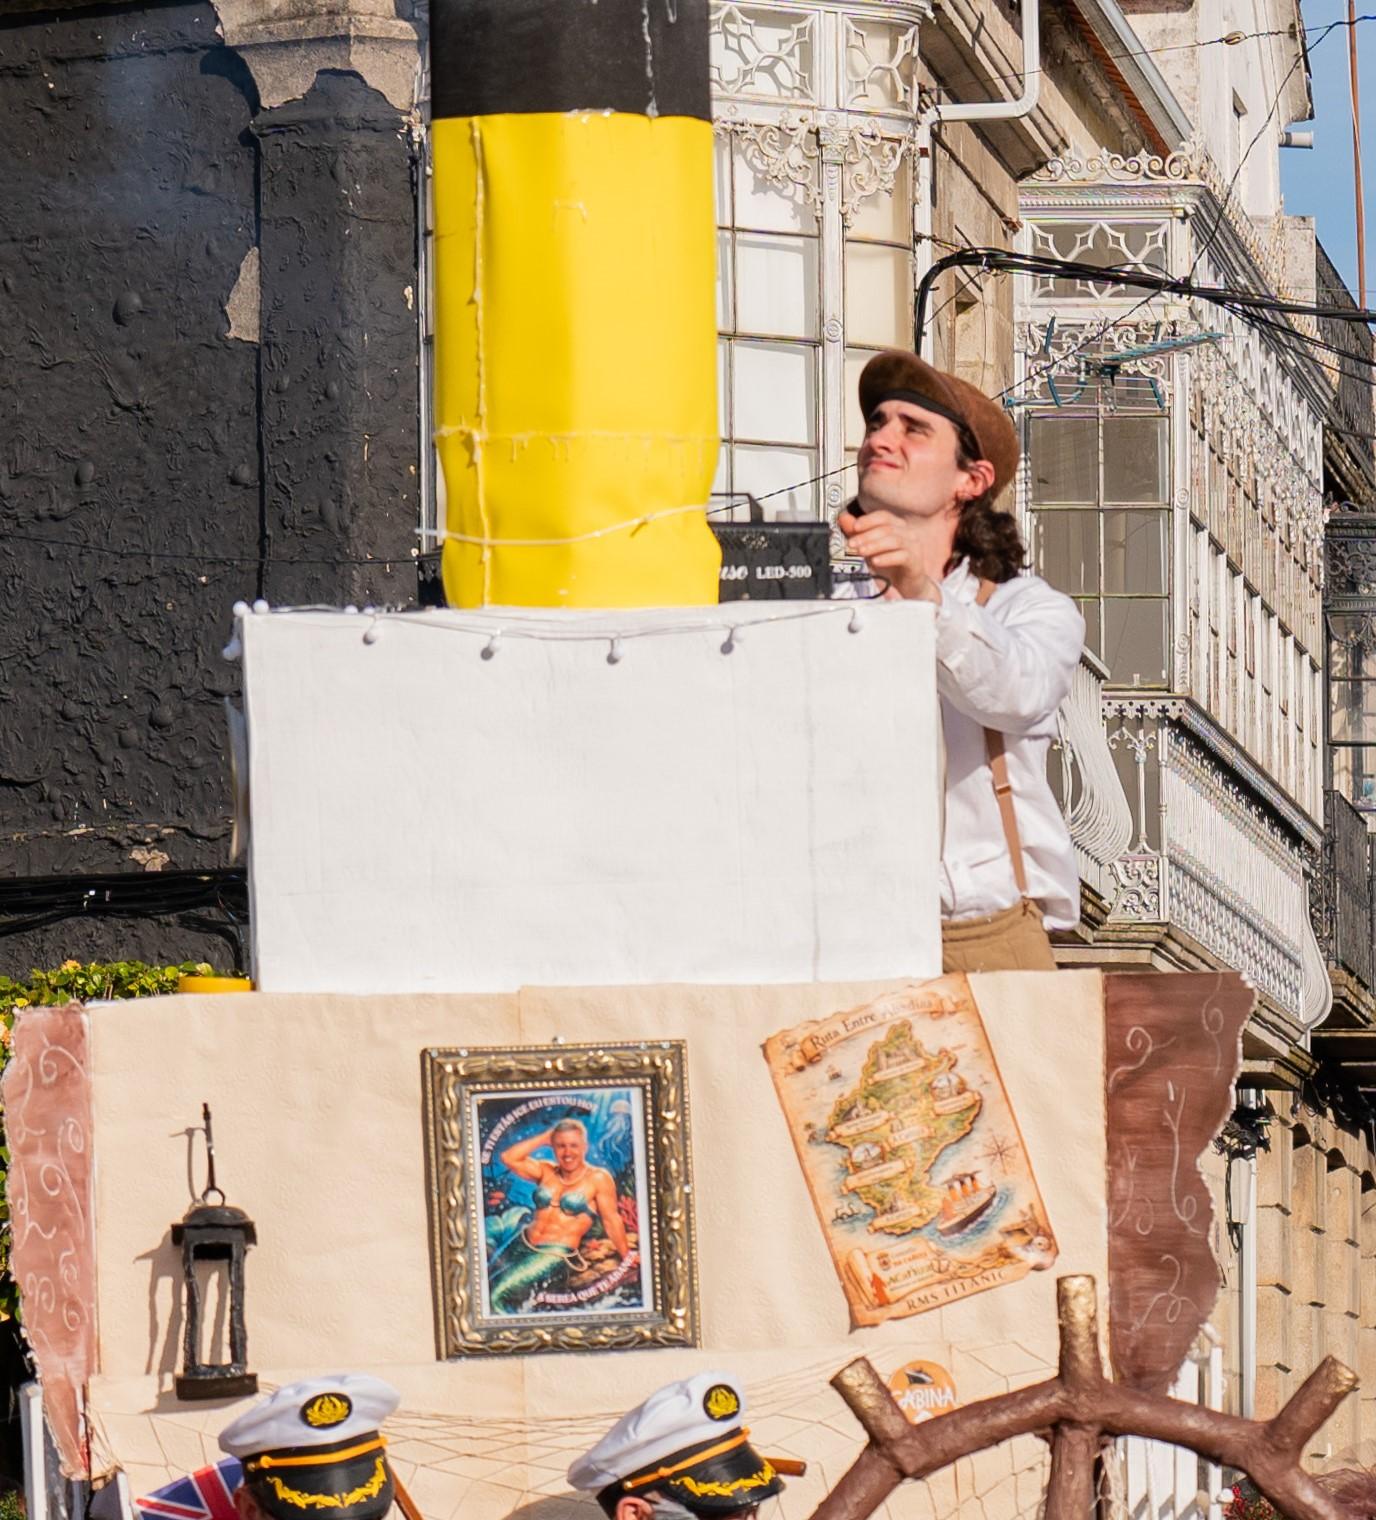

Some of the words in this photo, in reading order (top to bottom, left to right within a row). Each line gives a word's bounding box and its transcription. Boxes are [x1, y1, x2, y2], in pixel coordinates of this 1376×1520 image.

[755, 564, 812, 580] LED-500
[809, 1029, 841, 1051] Ruta
[841, 1011, 878, 1033] Entre
[906, 1291, 940, 1311] RMS
[943, 1269, 1008, 1298] TITANIC
